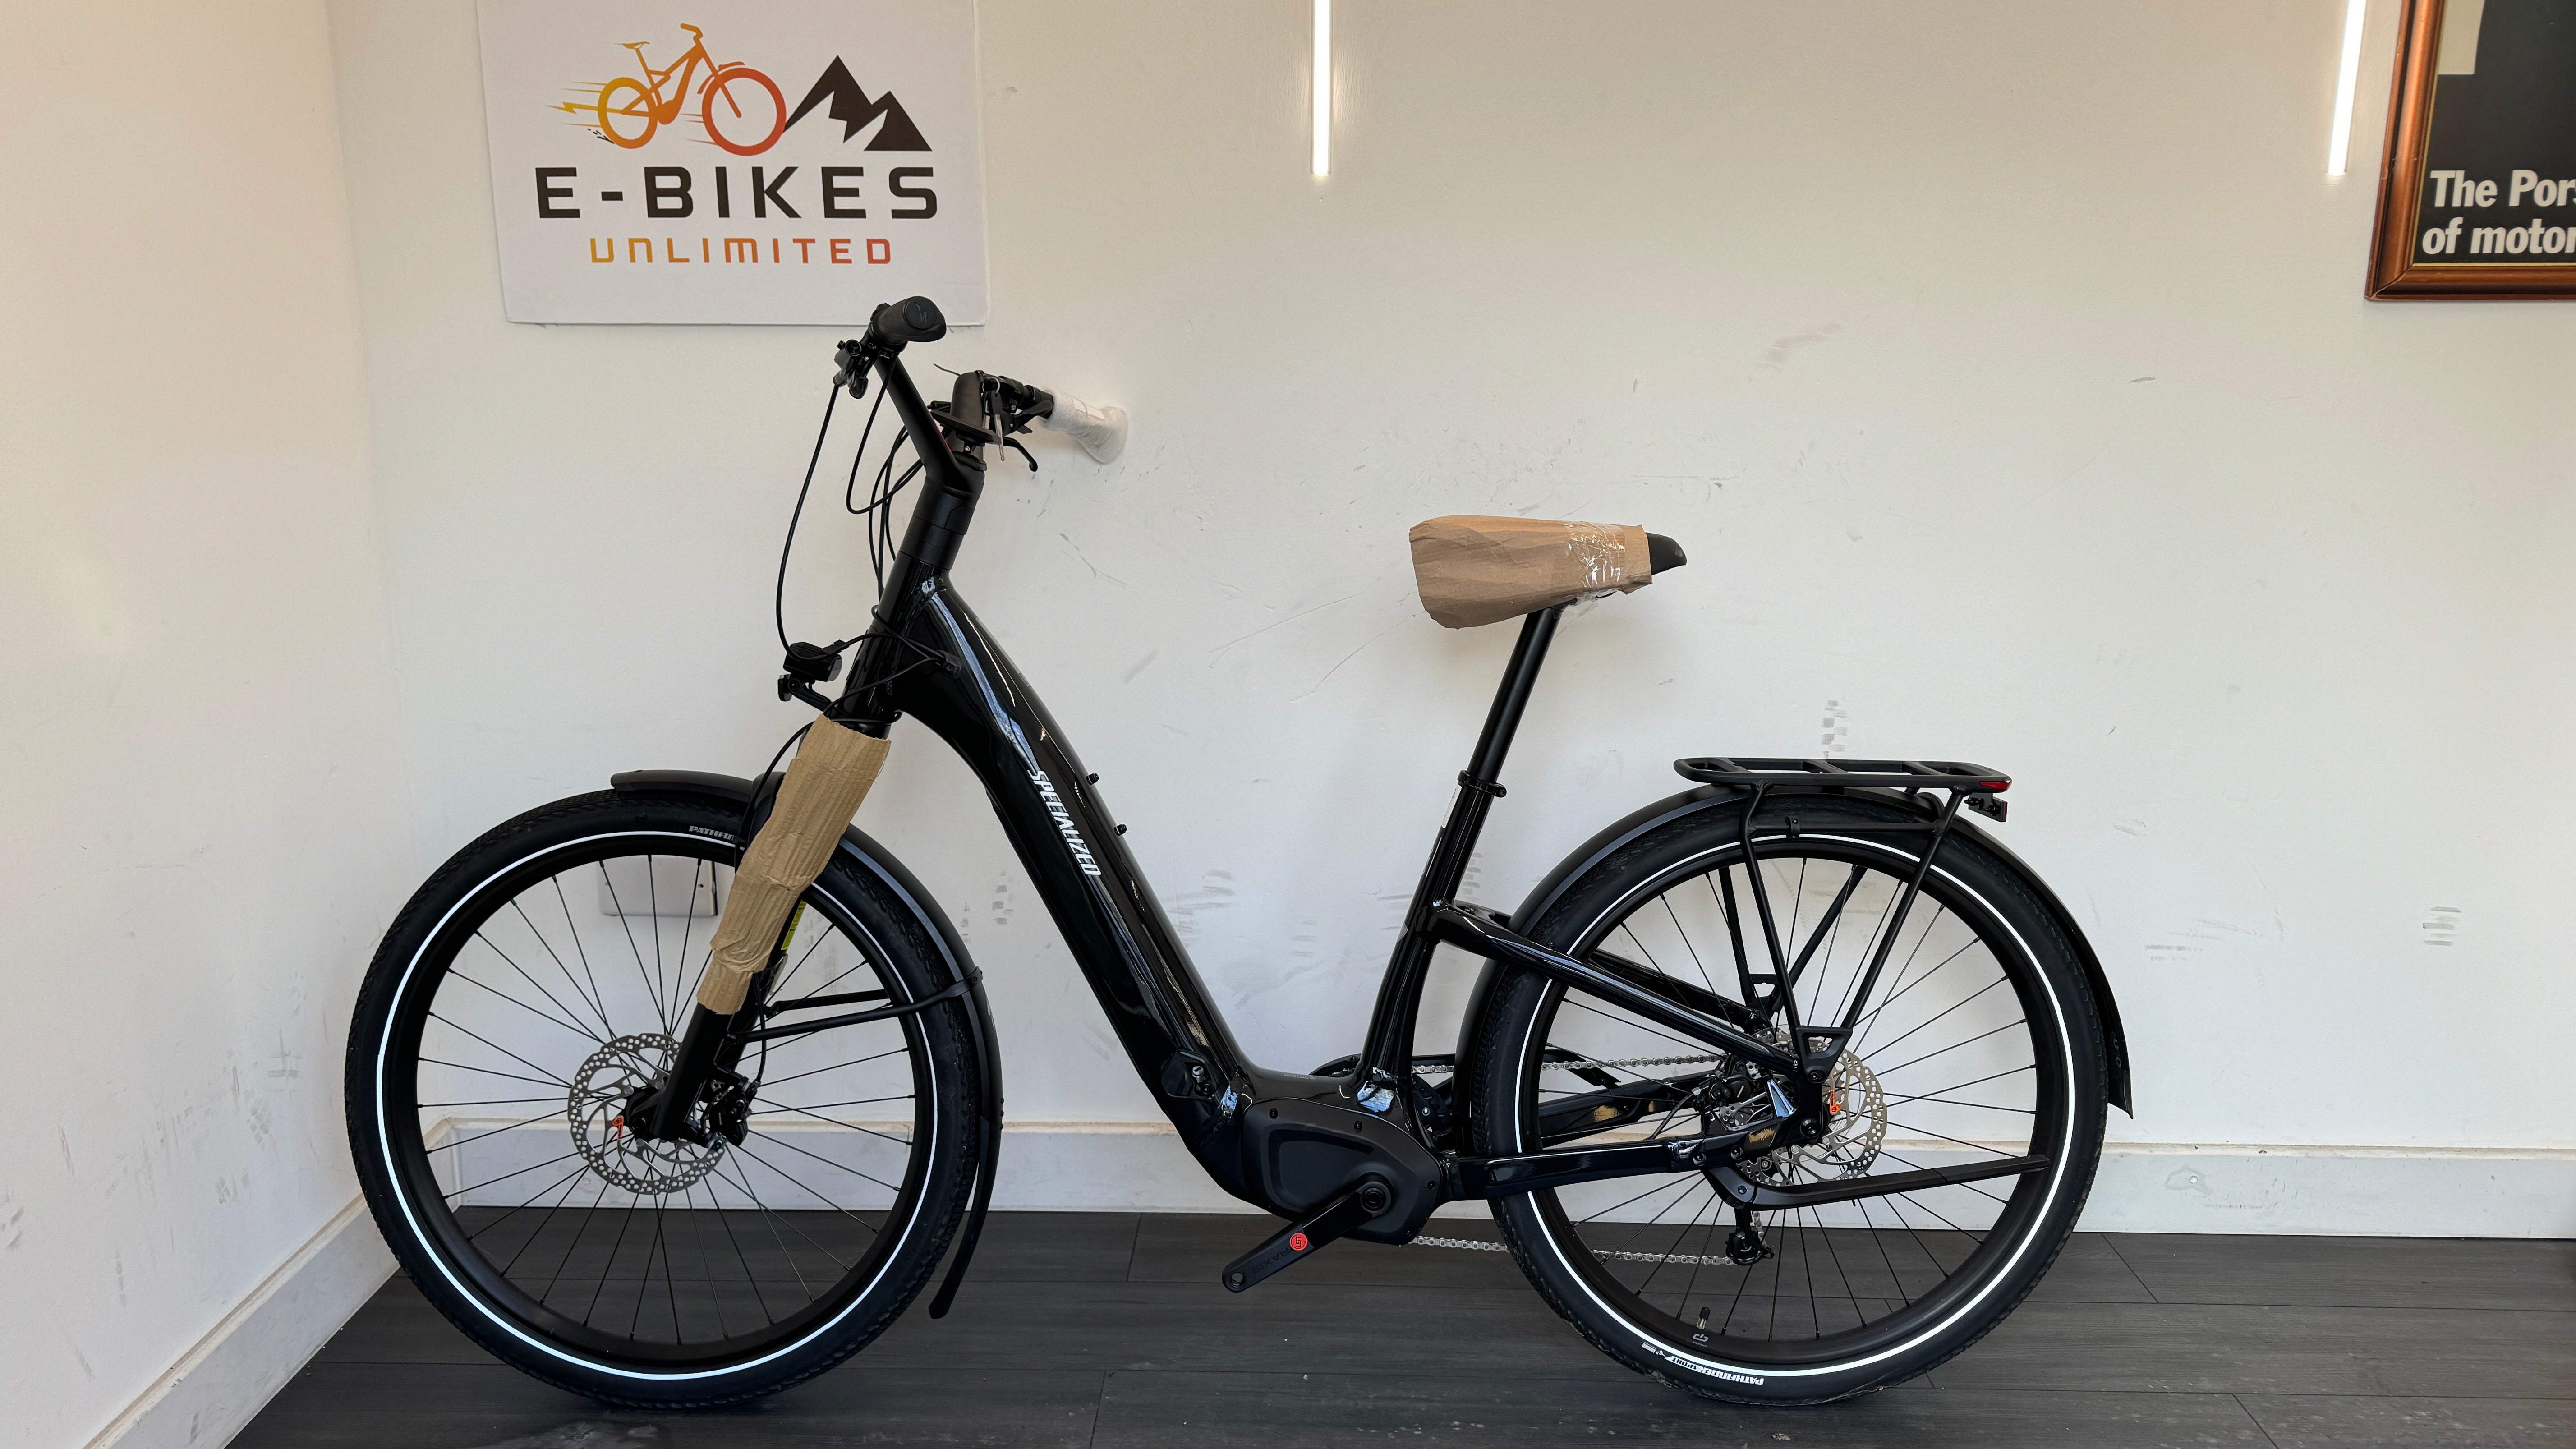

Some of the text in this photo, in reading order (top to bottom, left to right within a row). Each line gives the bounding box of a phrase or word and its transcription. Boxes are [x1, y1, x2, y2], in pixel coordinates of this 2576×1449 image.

[535, 166, 938, 219] E-BIKES
[2430, 170, 2576, 207] The Por
[590, 237, 892, 264] UNLIMITED
[2422, 217, 2463, 254] of
[1027, 769, 1102, 876] SPECIALIZED
[1251, 1247, 1291, 1273] RAXIS
[1672, 1357, 1765, 1386] PATHFINDER SPORT
